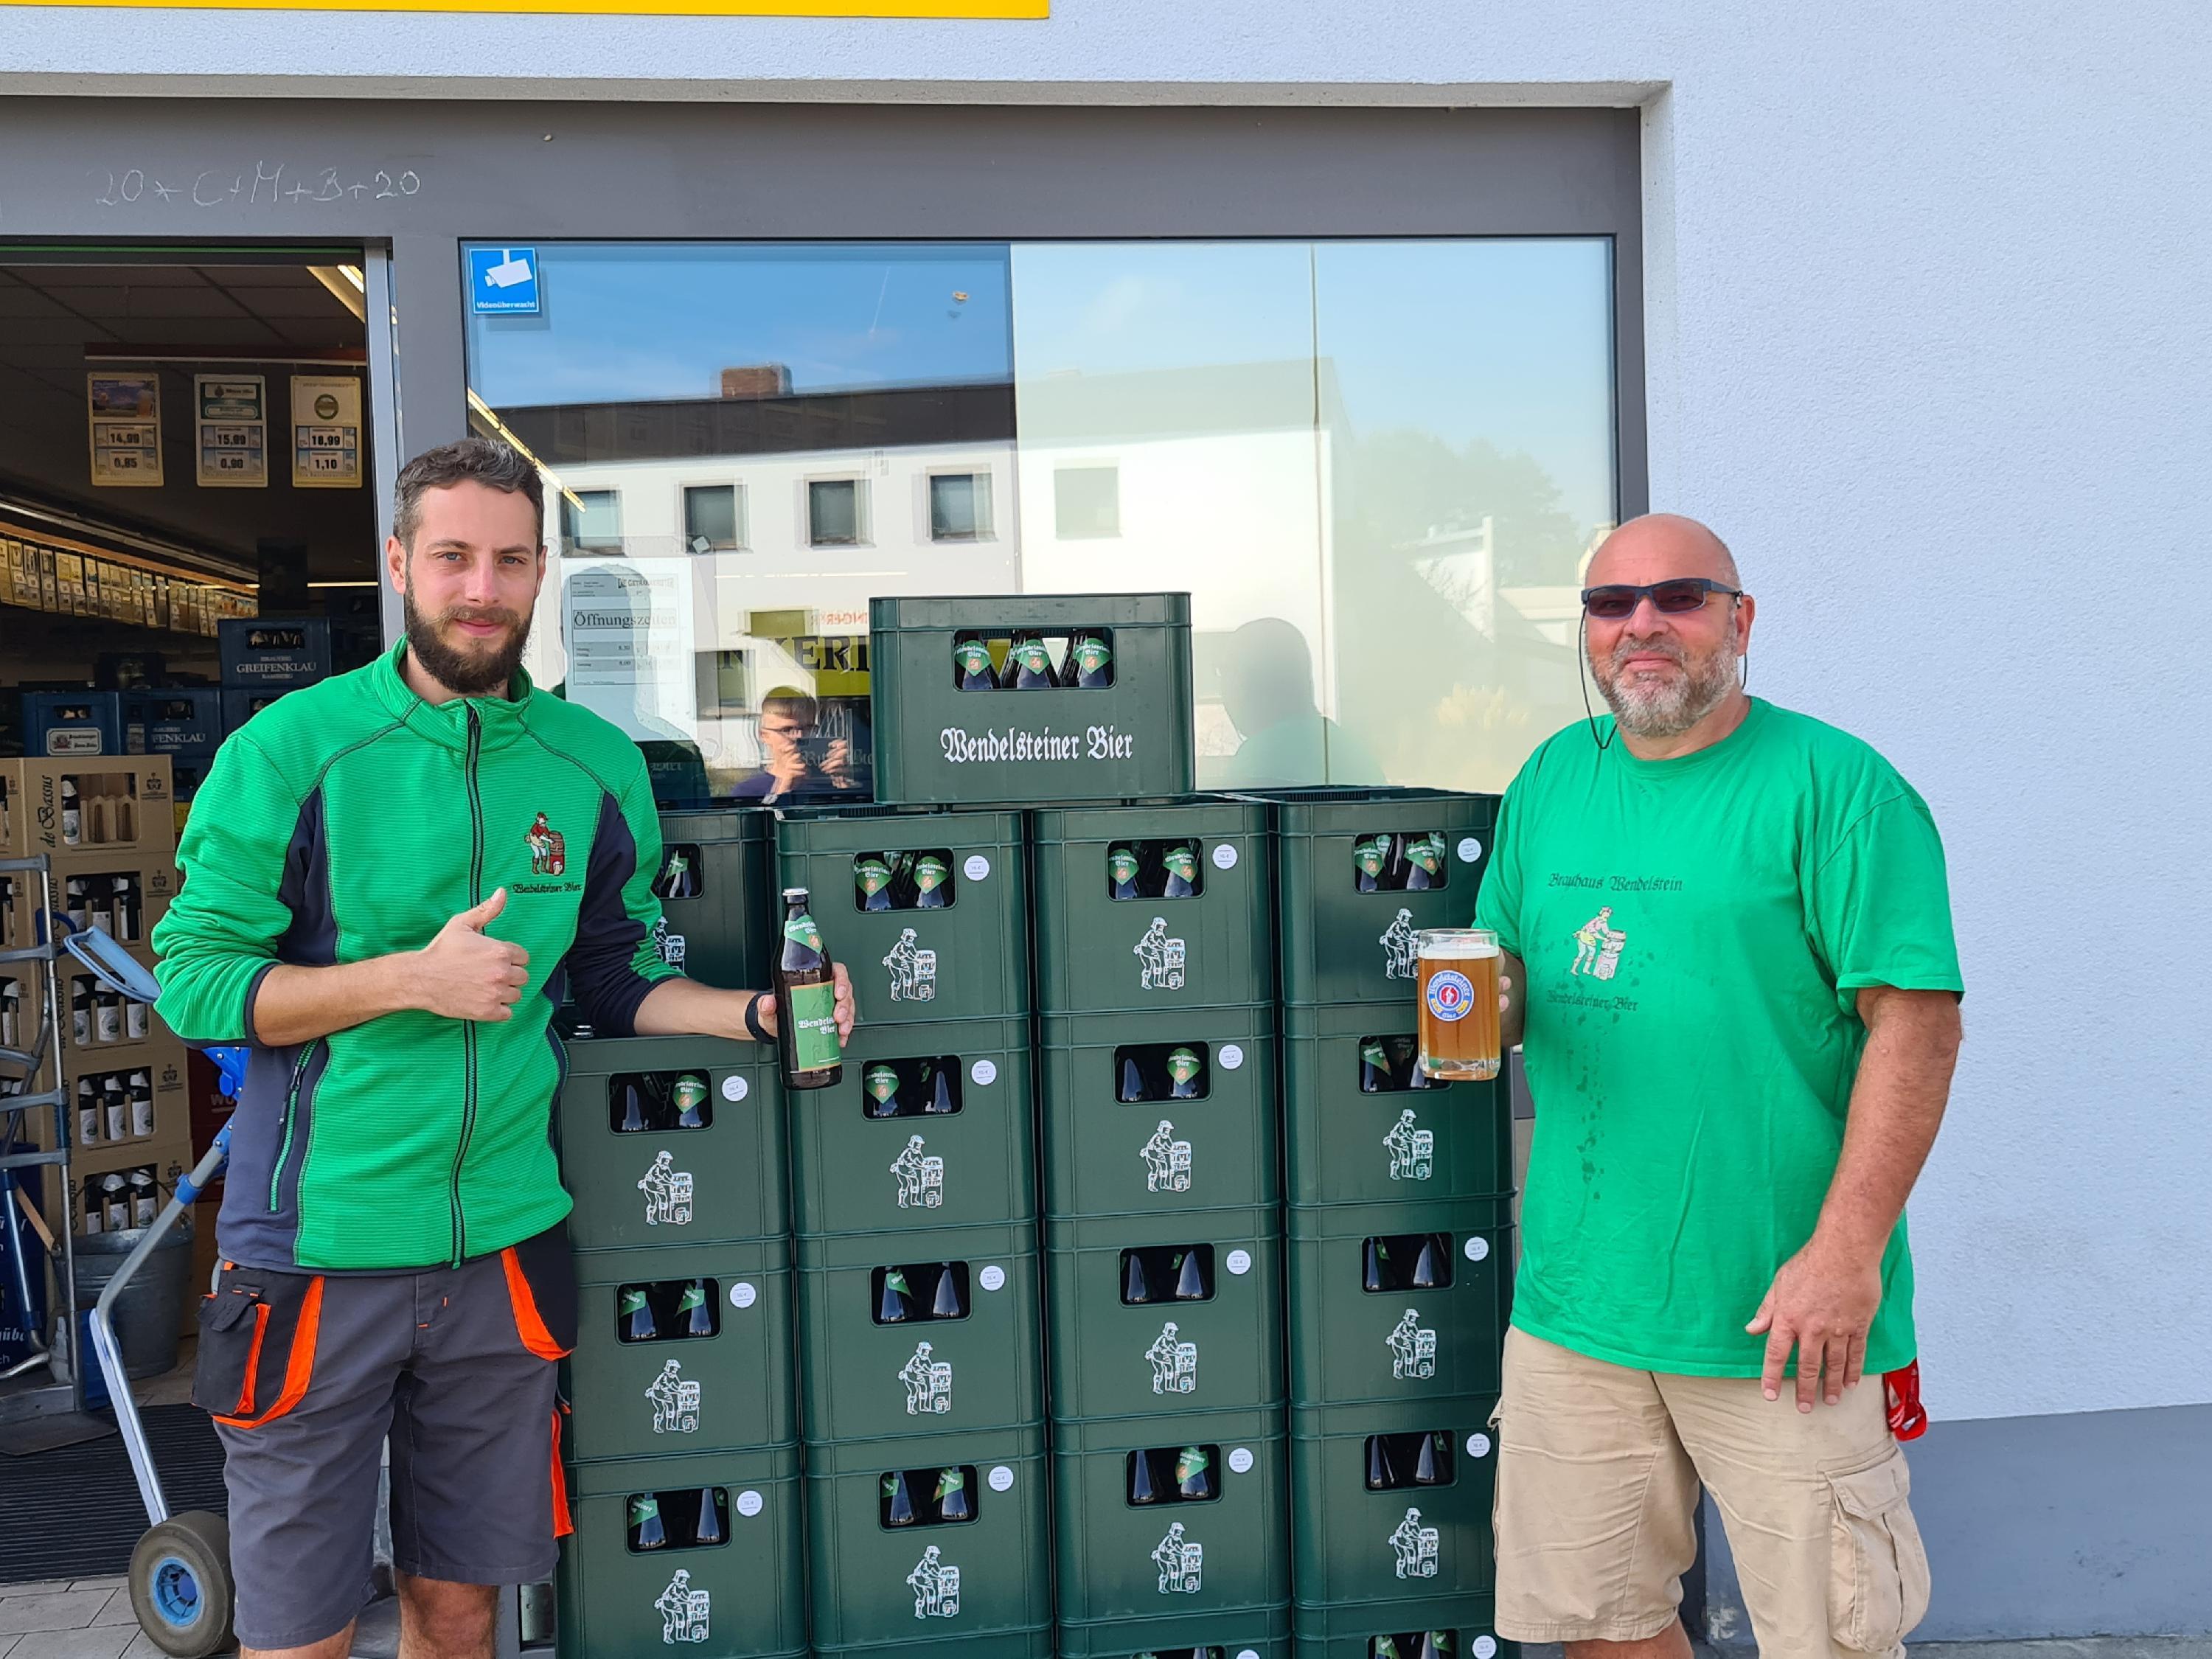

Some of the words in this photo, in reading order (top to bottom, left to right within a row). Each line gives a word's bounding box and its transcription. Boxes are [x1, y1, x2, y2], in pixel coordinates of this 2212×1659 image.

[476, 300, 535, 308] Videoüberwacht
[316, 459, 337, 470] 1,10
[574, 611, 677, 629] Öffnungszeiten
[236, 661, 317, 674] GREIFENKLAU
[940, 726, 1079, 763] Wendelsteiner
[1086, 725, 1133, 760] Bier
